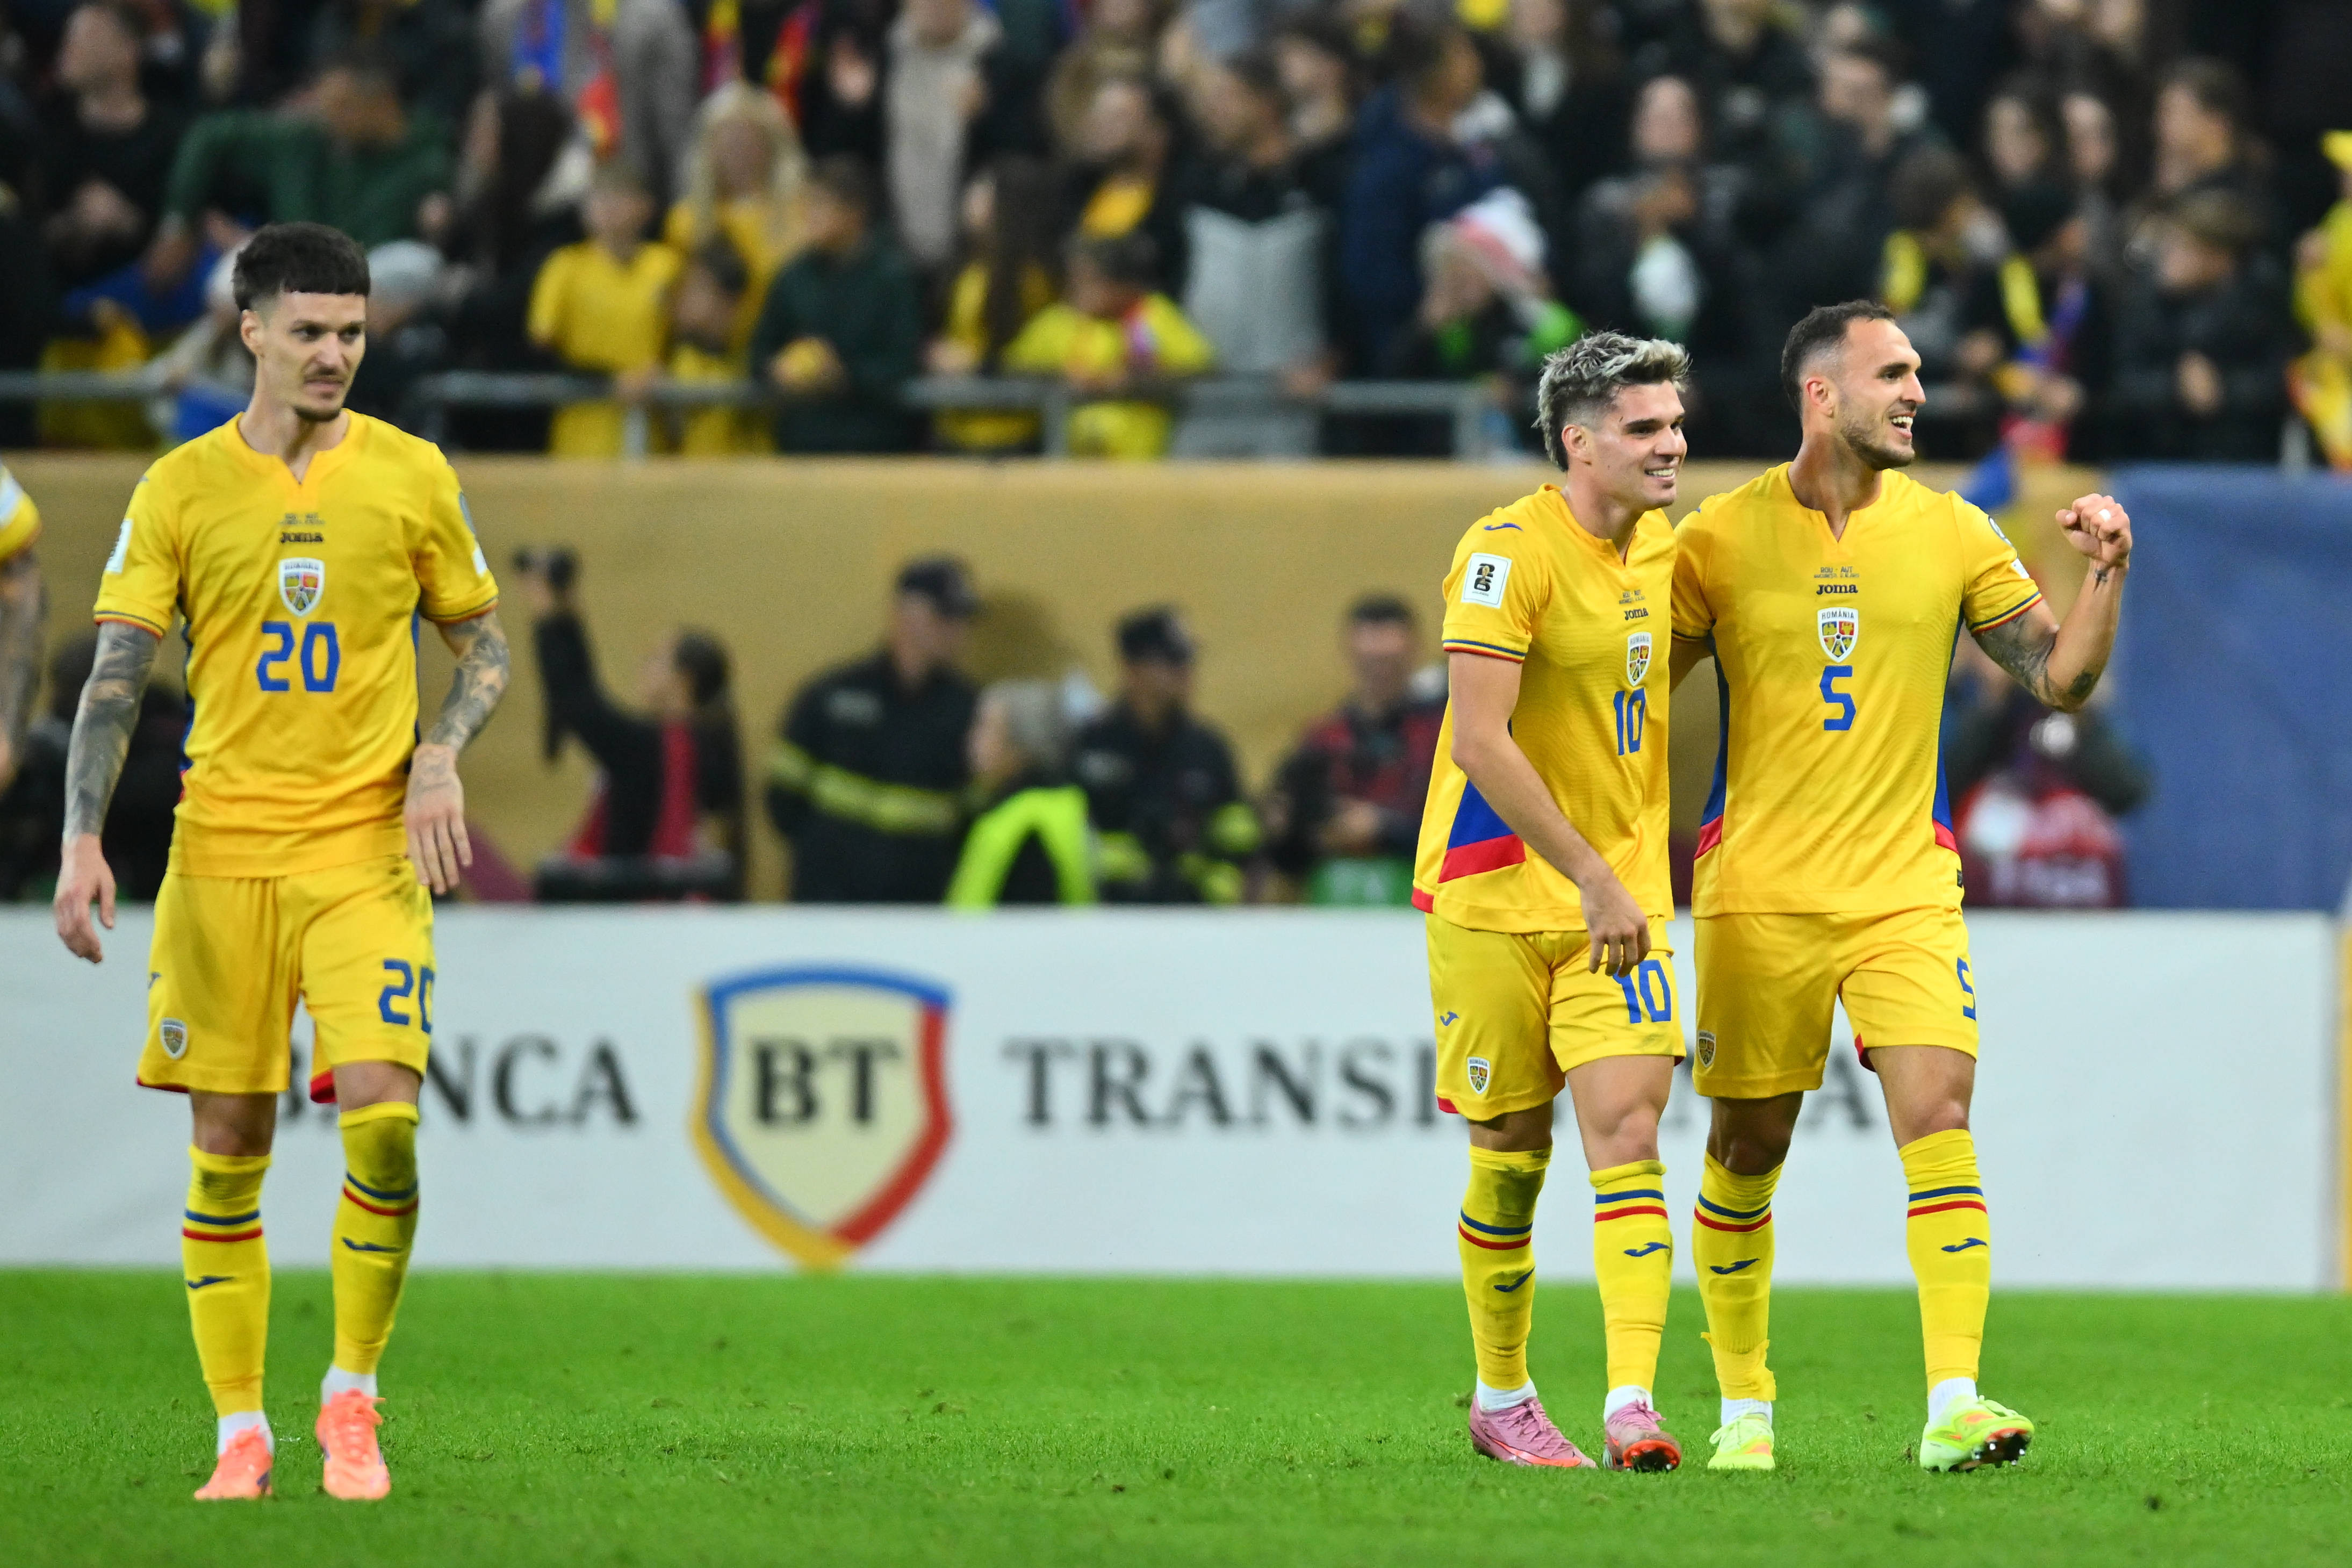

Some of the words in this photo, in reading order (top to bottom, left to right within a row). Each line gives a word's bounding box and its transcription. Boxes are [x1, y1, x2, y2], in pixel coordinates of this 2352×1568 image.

[256, 621, 340, 692] 20
[1613, 687, 1646, 756] 10
[1819, 665, 1856, 730] 5
[1613, 960, 1671, 1024] 10
[1957, 956, 1976, 1021] 5
[752, 1036, 904, 1127] BT
